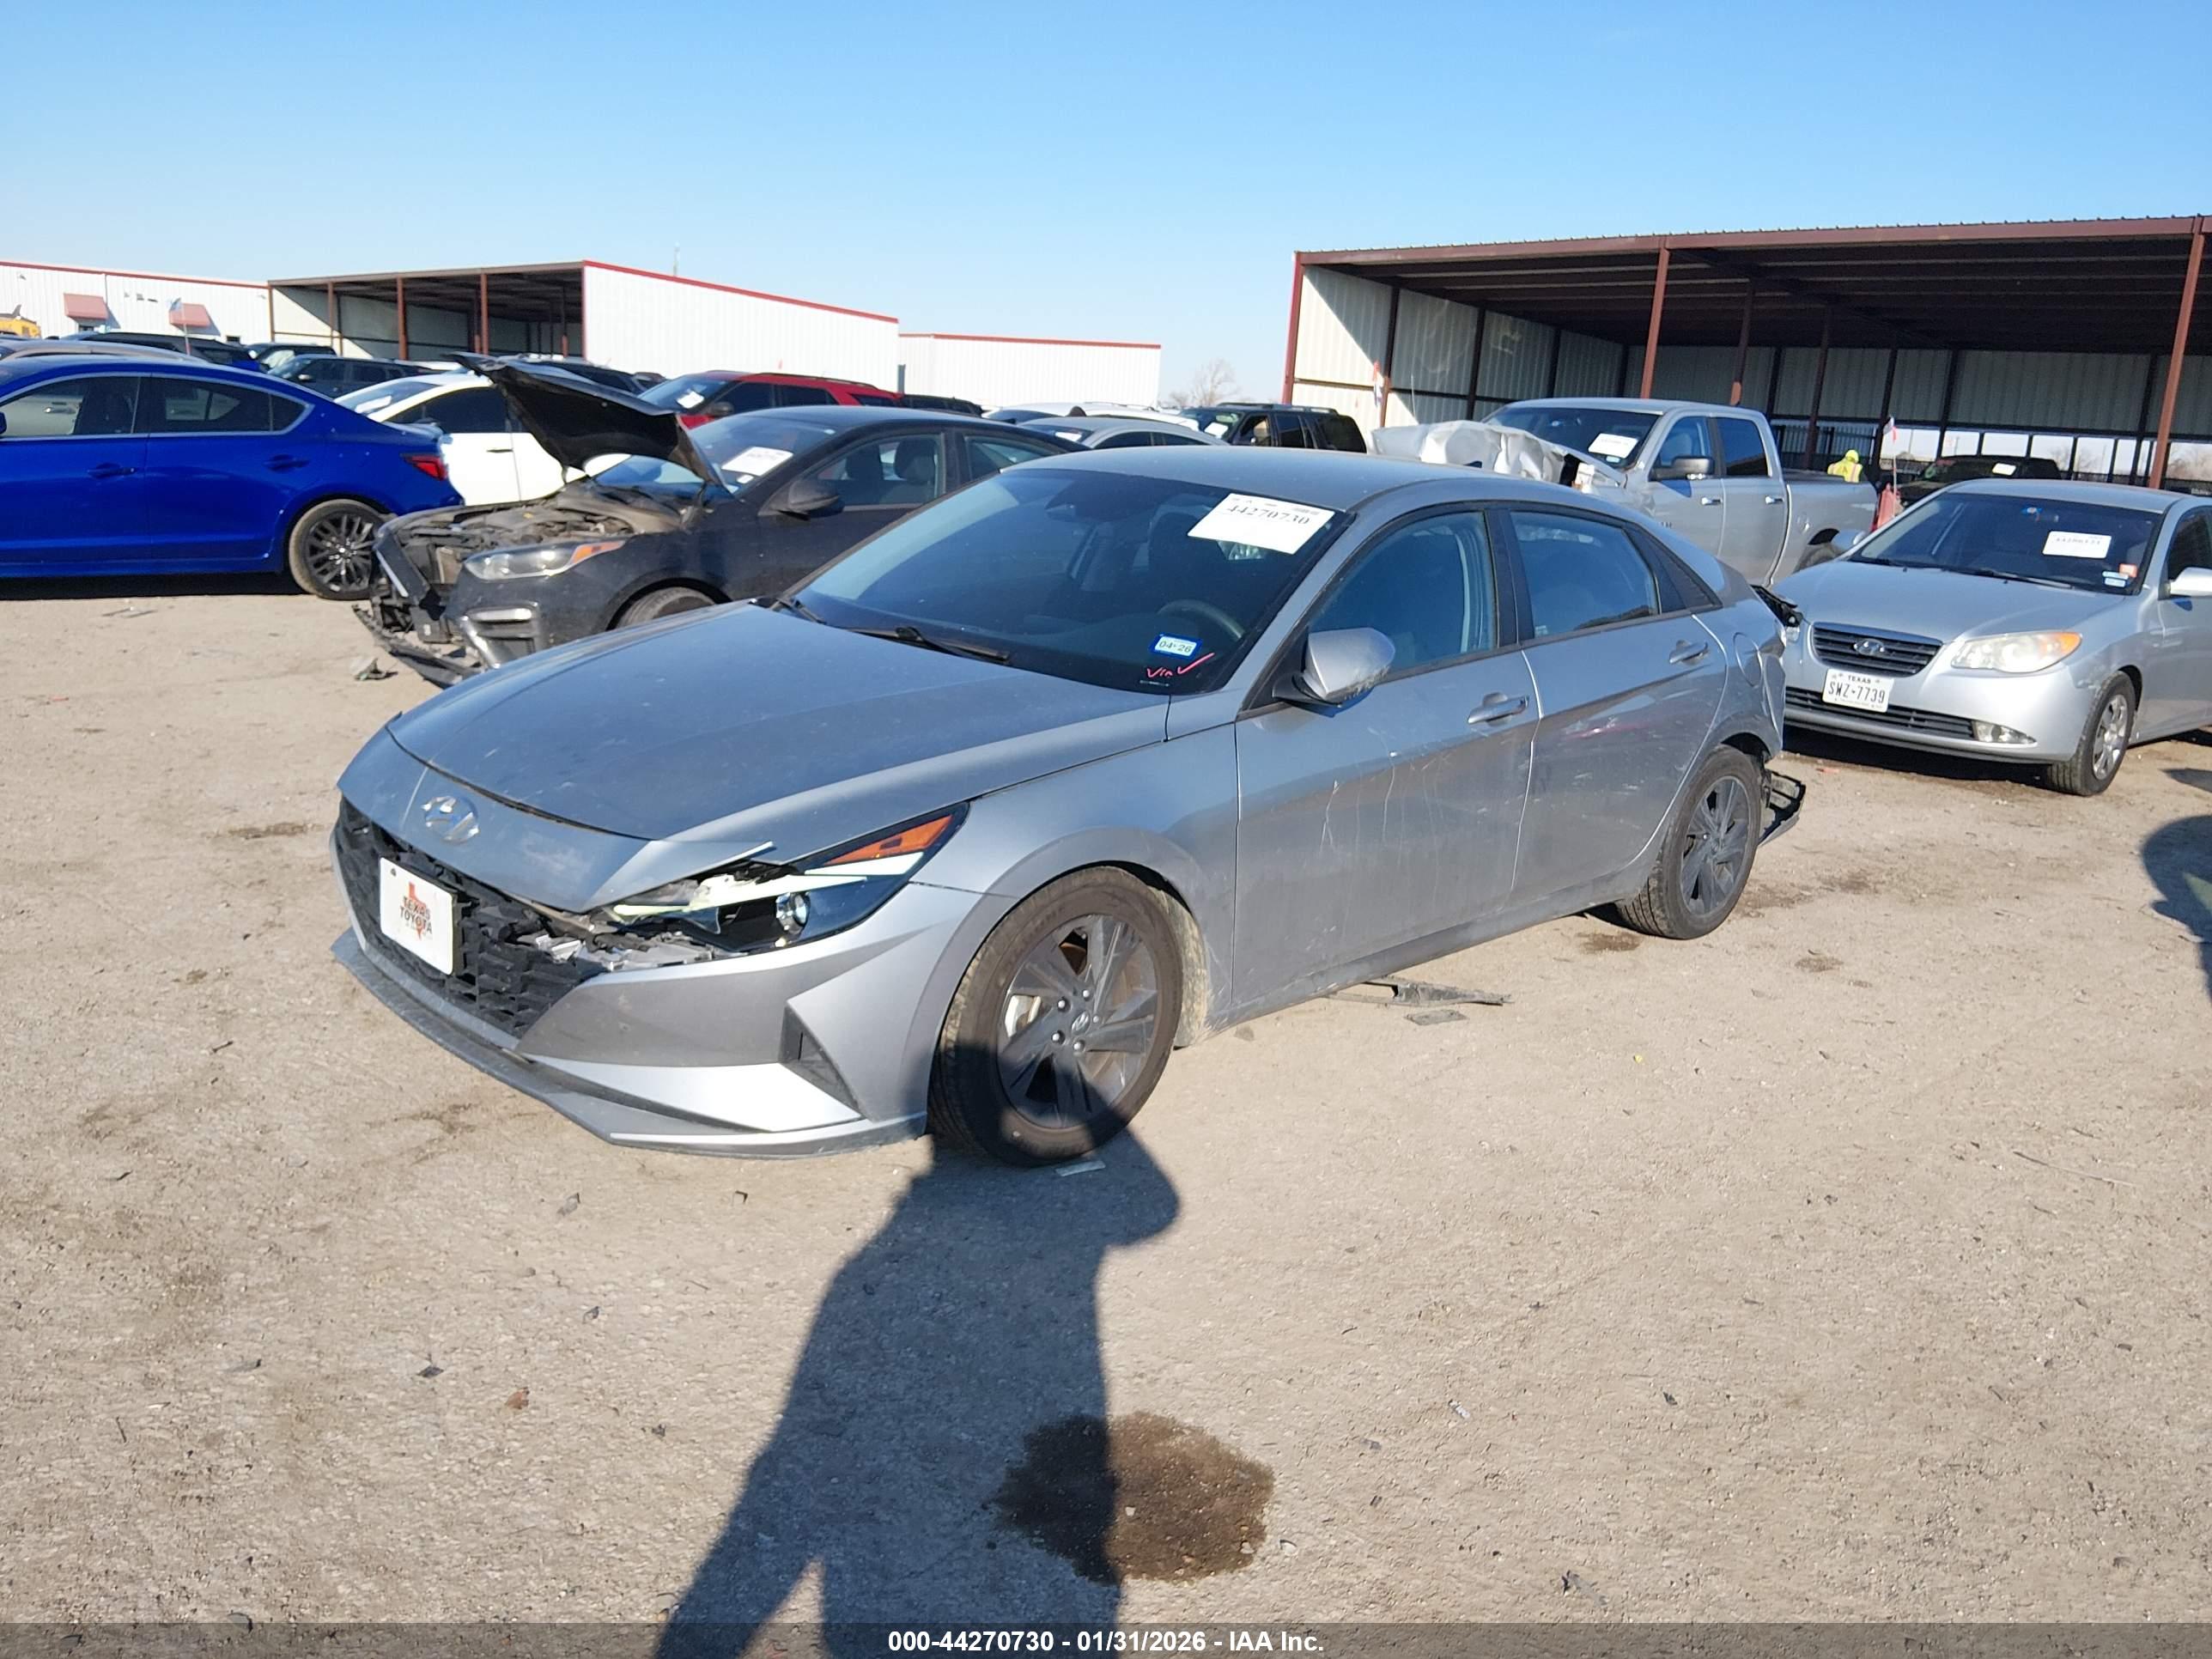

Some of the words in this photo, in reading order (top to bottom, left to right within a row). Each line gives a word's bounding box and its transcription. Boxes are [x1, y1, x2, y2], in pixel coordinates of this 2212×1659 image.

[1227, 506, 1310, 525] 44270730
[1848, 675, 1871, 684] TEXAS
[400, 905, 433, 934] TOYOTA
[404, 896, 431, 921] TEXAS
